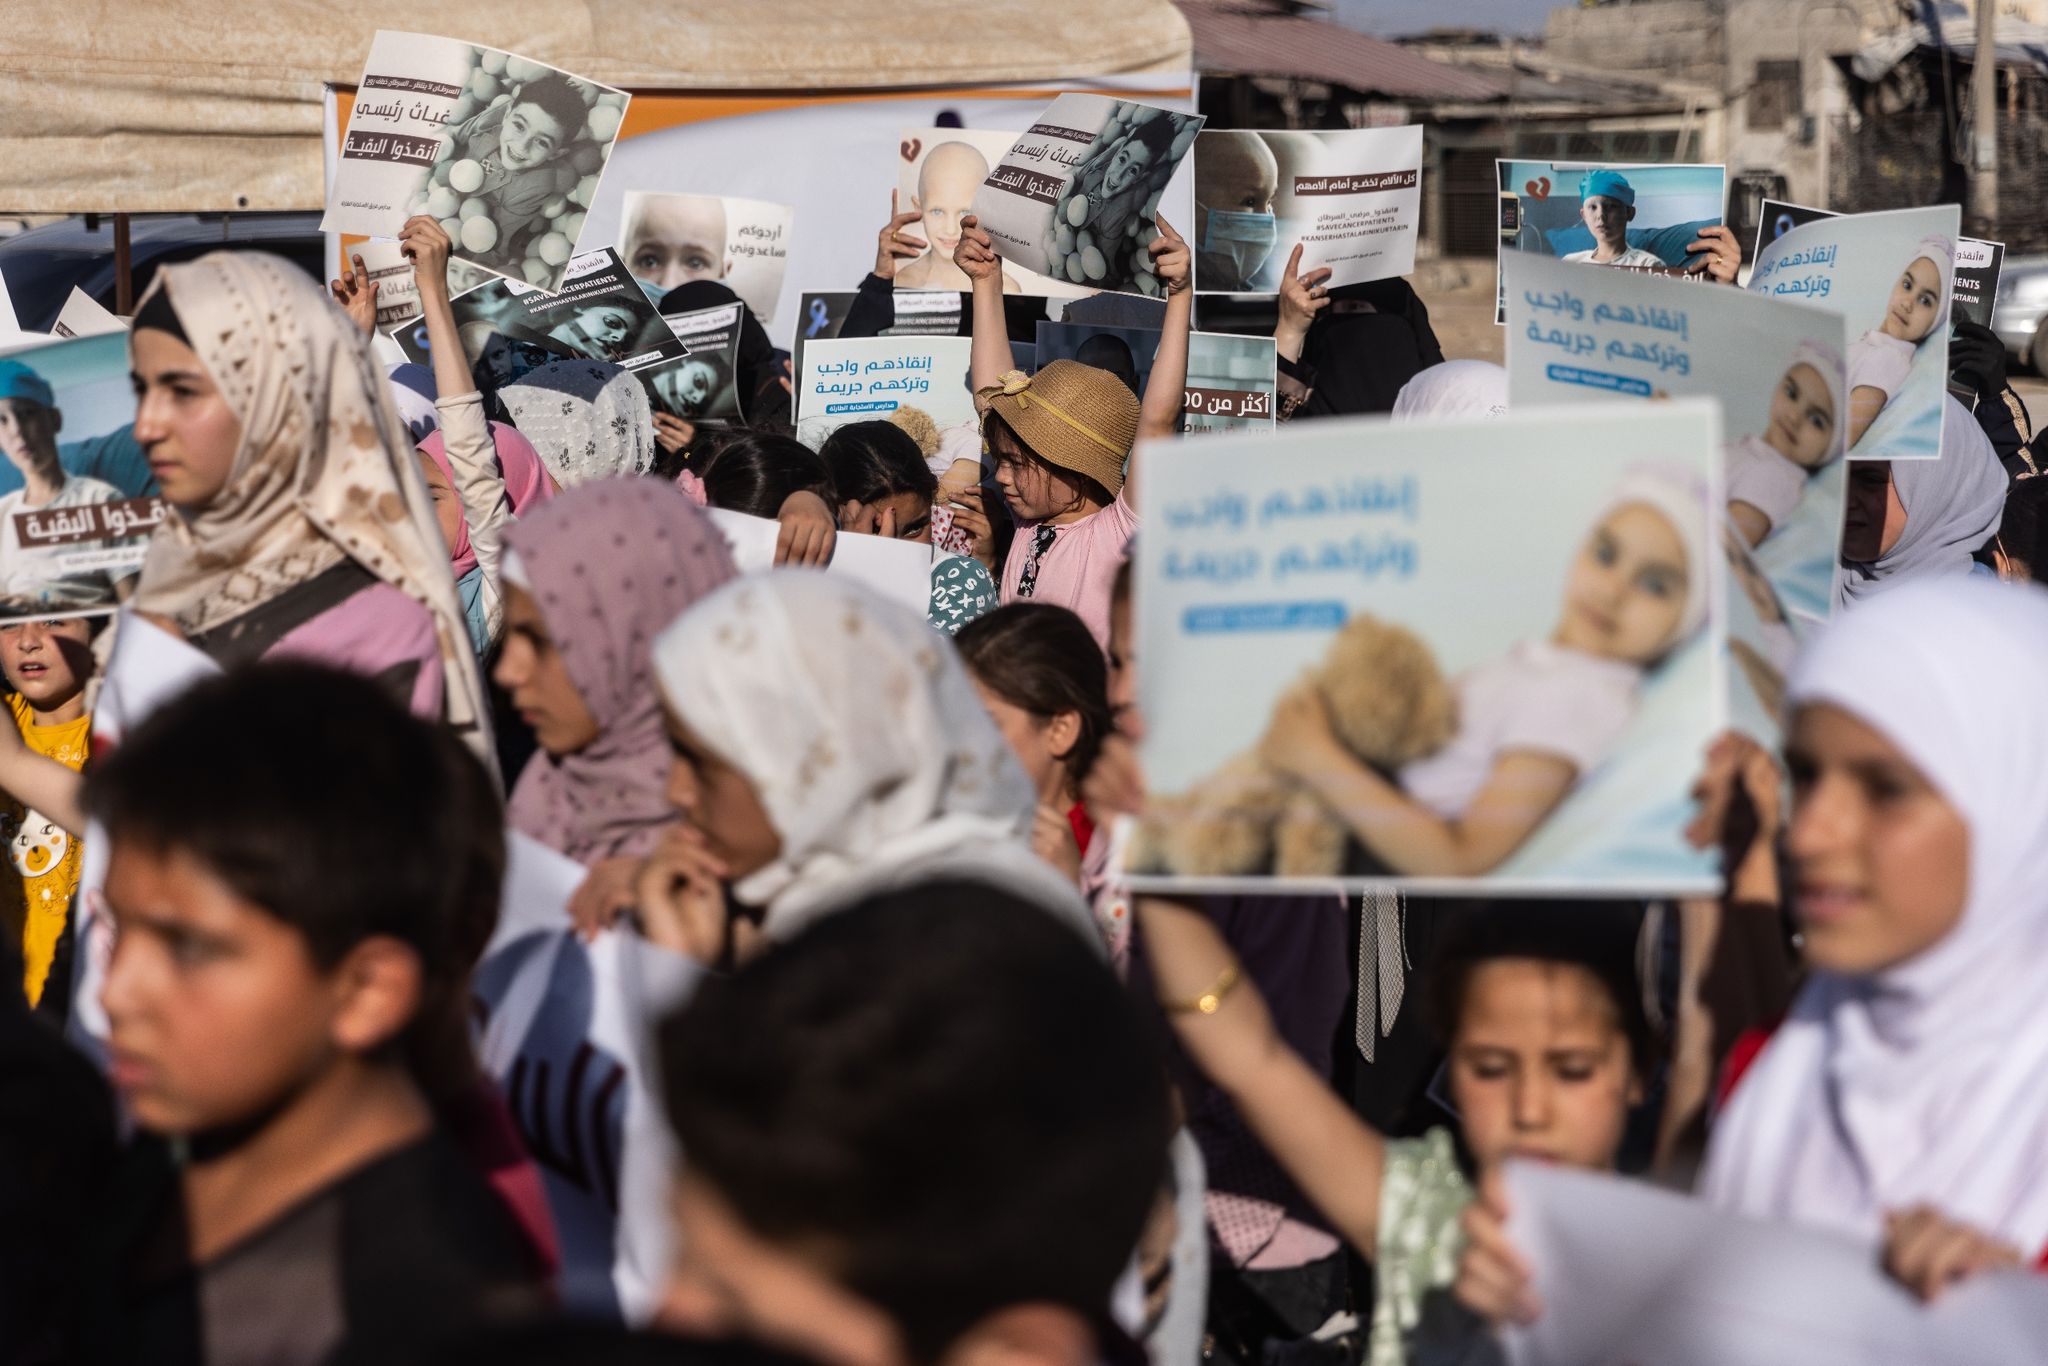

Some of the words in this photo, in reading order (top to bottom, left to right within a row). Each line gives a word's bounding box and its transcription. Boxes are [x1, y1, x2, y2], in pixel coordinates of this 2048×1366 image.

[356, 100, 405, 123] رئيسي
[409, 102, 451, 128] غياث
[346, 137, 388, 157] البقية
[391, 140, 441, 161] أنقذوا
[1010, 144, 1050, 162] رئيسي
[1050, 146, 1081, 169] غياث
[1026, 176, 1067, 199] أنقذوا
[1775, 244, 1837, 274] إنقاذهم
[523, 274, 618, 306] #SAVENCERPATIENTS
[1773, 275, 1831, 298] وتركهم
[817, 359, 859, 377] واجب
[865, 356, 932, 375] إنقاذهم
[815, 380, 863, 397] جريمة
[869, 376, 929, 395] وتركهم
[1207, 397, 1233, 415] من
[1237, 392, 1270, 417] أكثر
[26, 506, 96, 543] البقية
[101, 499, 167, 537] قذوا
